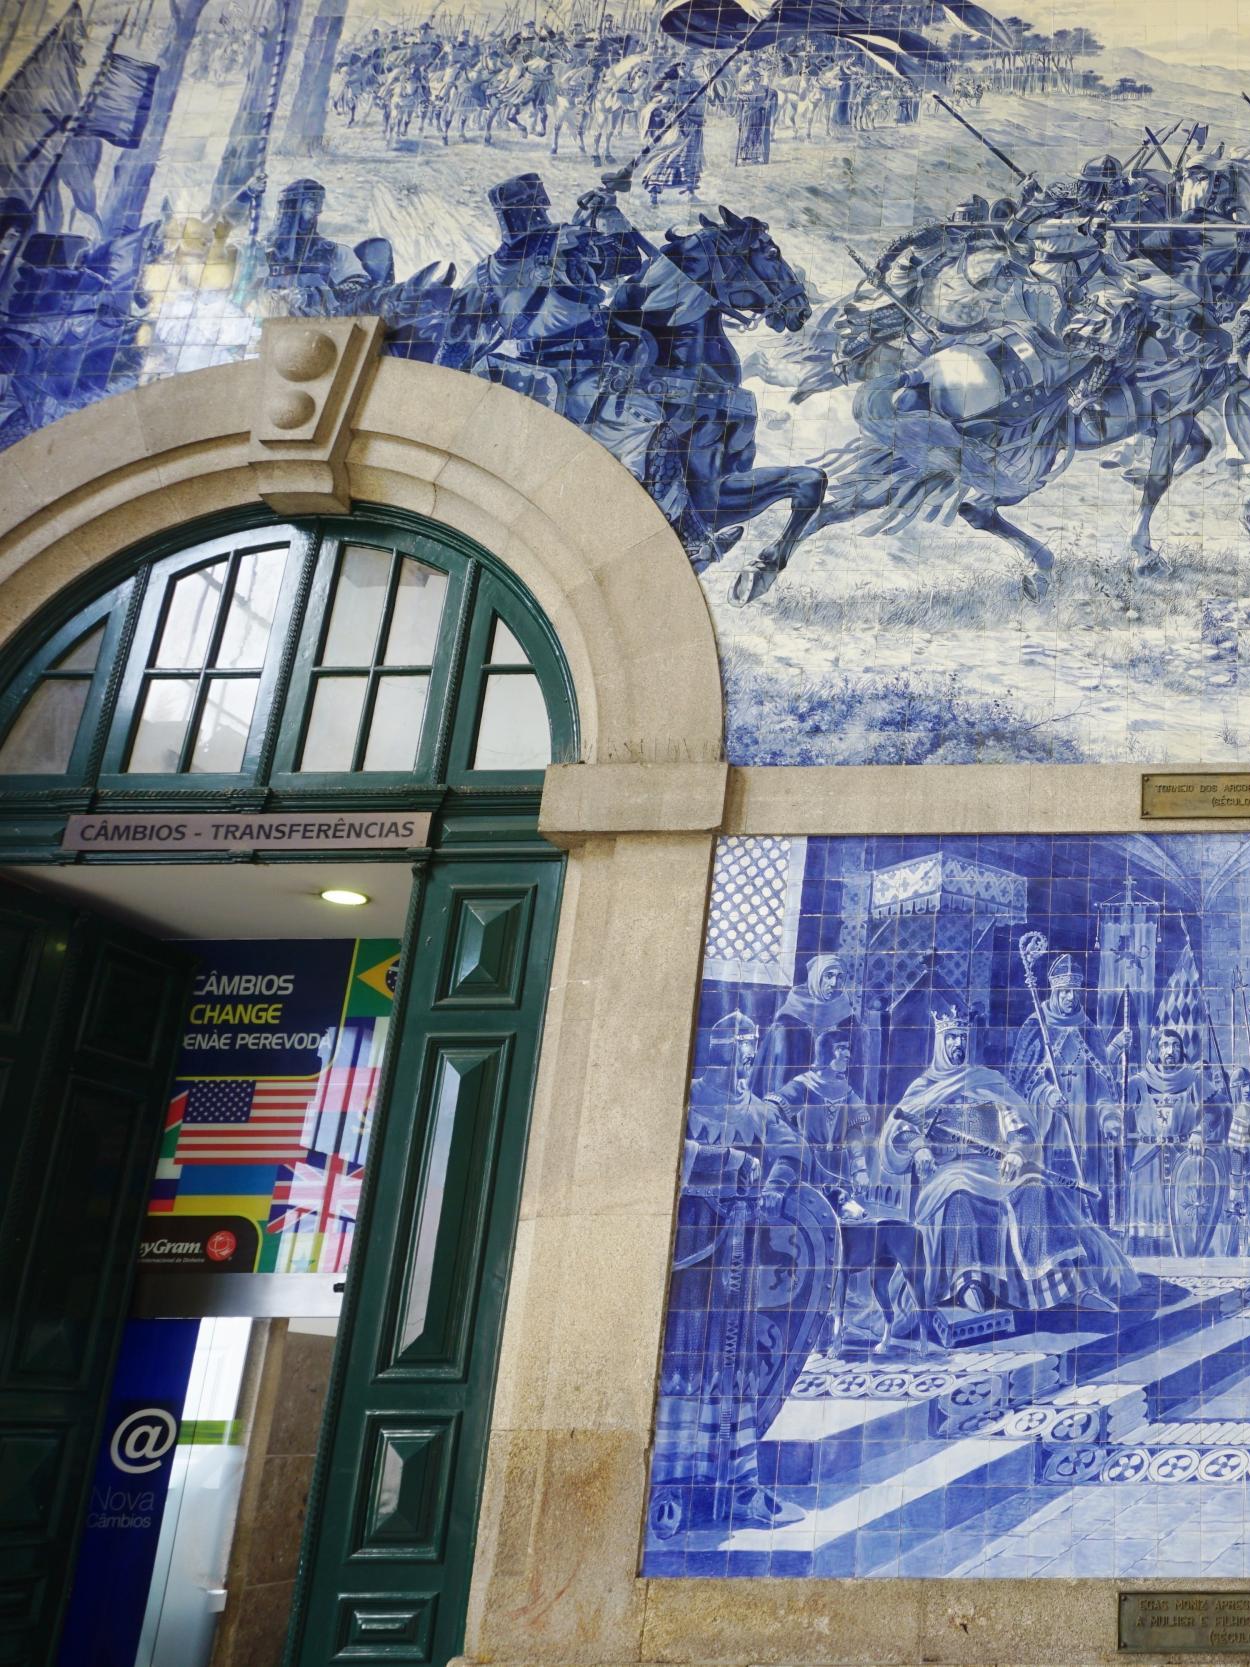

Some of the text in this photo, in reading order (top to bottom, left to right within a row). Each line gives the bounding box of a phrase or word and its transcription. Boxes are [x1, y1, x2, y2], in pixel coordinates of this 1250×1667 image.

[80, 819, 187, 841] CÂMBIOS
[211, 817, 415, 841] TRANSFERÊNCIAS
[192, 970, 295, 996] CÂMBIOS
[189, 1003, 283, 1025] CHANGE
[110, 1407, 177, 1474] @
[89, 1485, 154, 1512] Nova
[87, 1511, 152, 1529] Câmbios
[1175, 1600, 1207, 1610] MONIZ
[1150, 1616, 1195, 1627] MULHER
